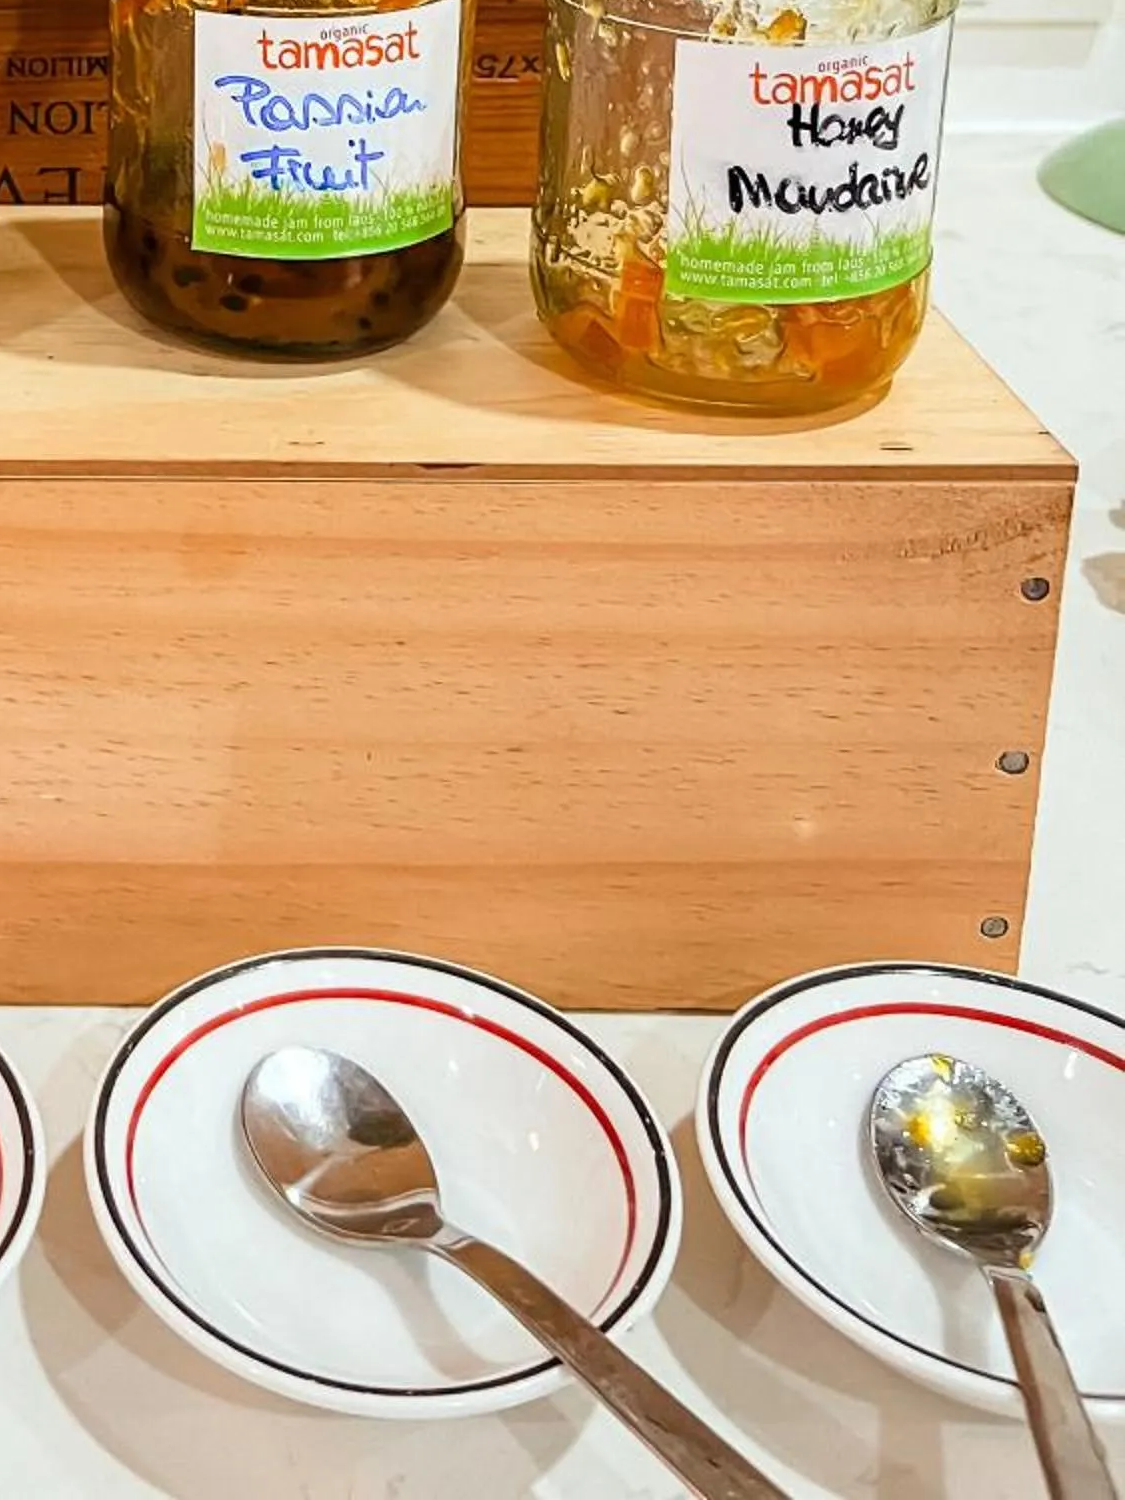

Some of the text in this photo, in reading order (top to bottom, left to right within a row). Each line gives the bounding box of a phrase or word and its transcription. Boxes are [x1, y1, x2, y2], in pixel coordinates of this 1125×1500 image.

[256, 20, 421, 70] tamasat
[320, 23, 369, 41] organic
[749, 51, 916, 105] tamasat
[818, 54, 868, 74] organic
[214, 75, 427, 132] Passion
[787, 103, 905, 150] Honey
[240, 138, 384, 192] Fruit
[314, 214, 344, 230] from
[680, 254, 764, 275] homemade
[801, 259, 834, 274] from
